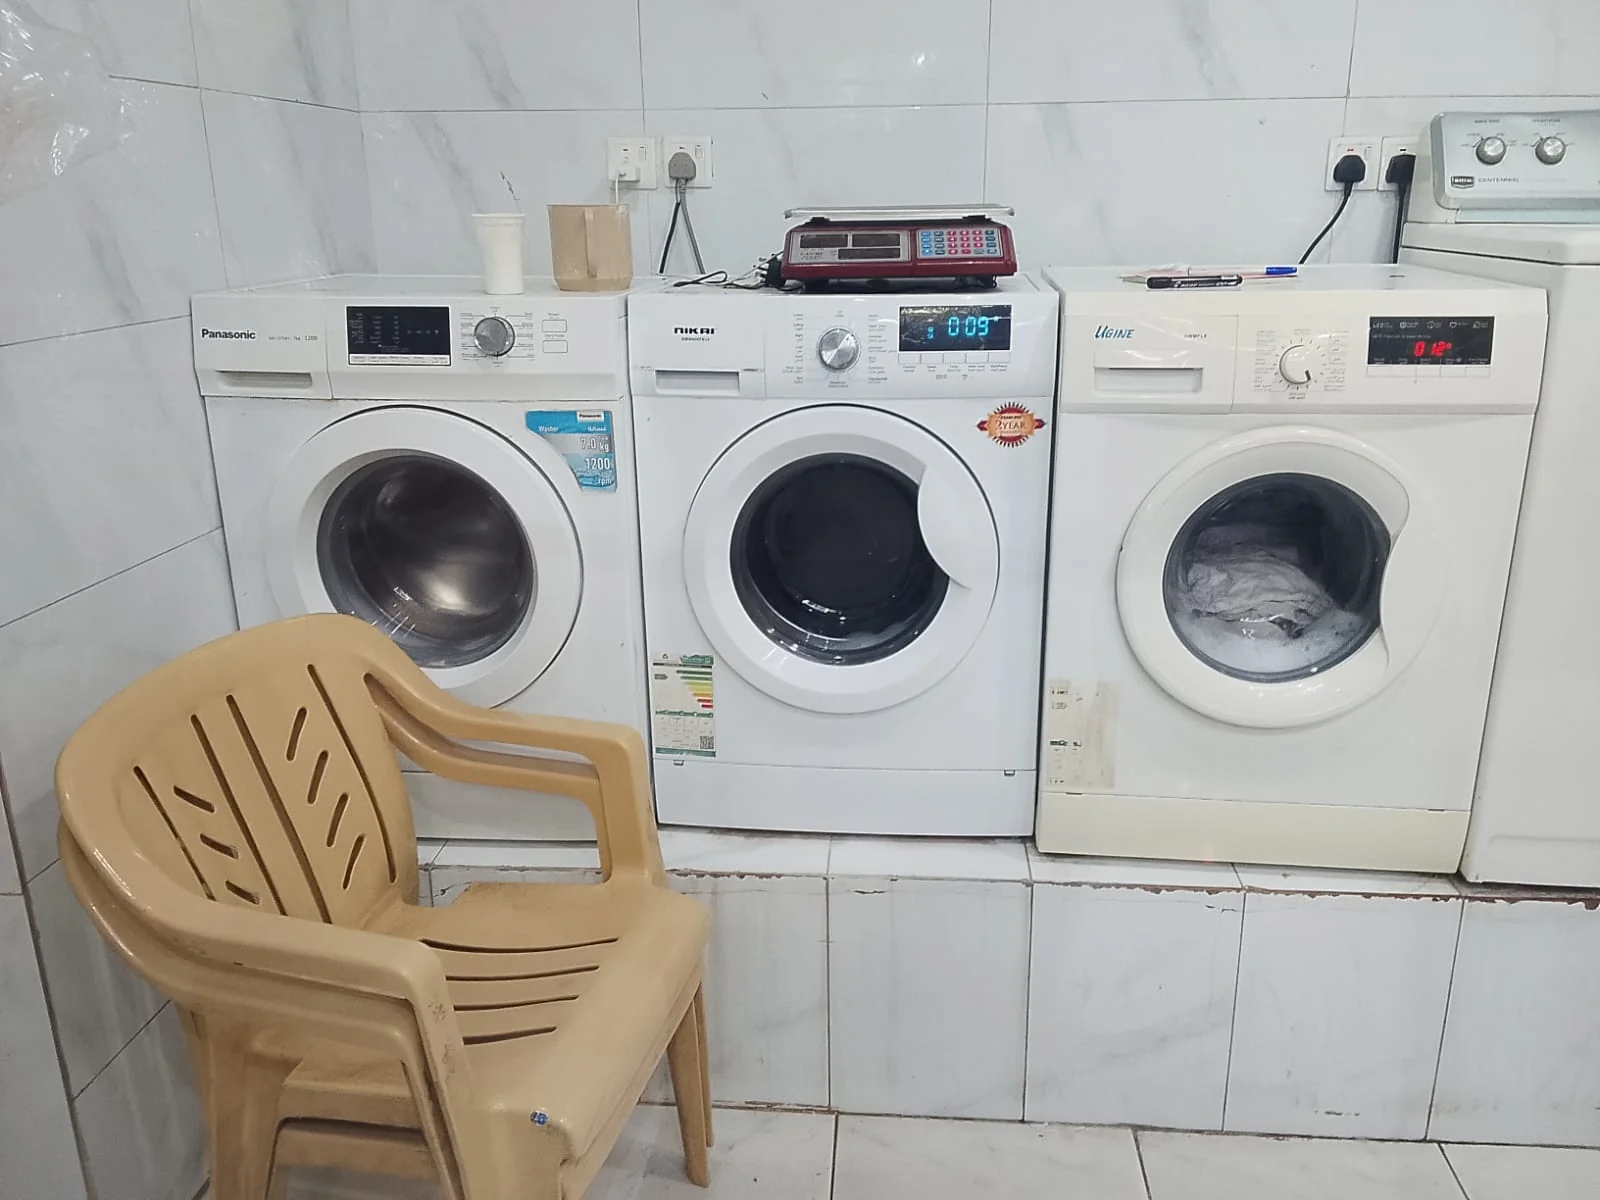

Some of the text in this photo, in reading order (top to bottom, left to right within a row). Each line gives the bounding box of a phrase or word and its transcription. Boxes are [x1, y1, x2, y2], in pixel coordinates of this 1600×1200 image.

[201, 328, 257, 341] Panasonic
[1002, 421, 1026, 430] YEAR
[581, 438, 609, 453] 7.0 kg
[585, 457, 610, 470] 1200
[598, 478, 612, 488] rpm
